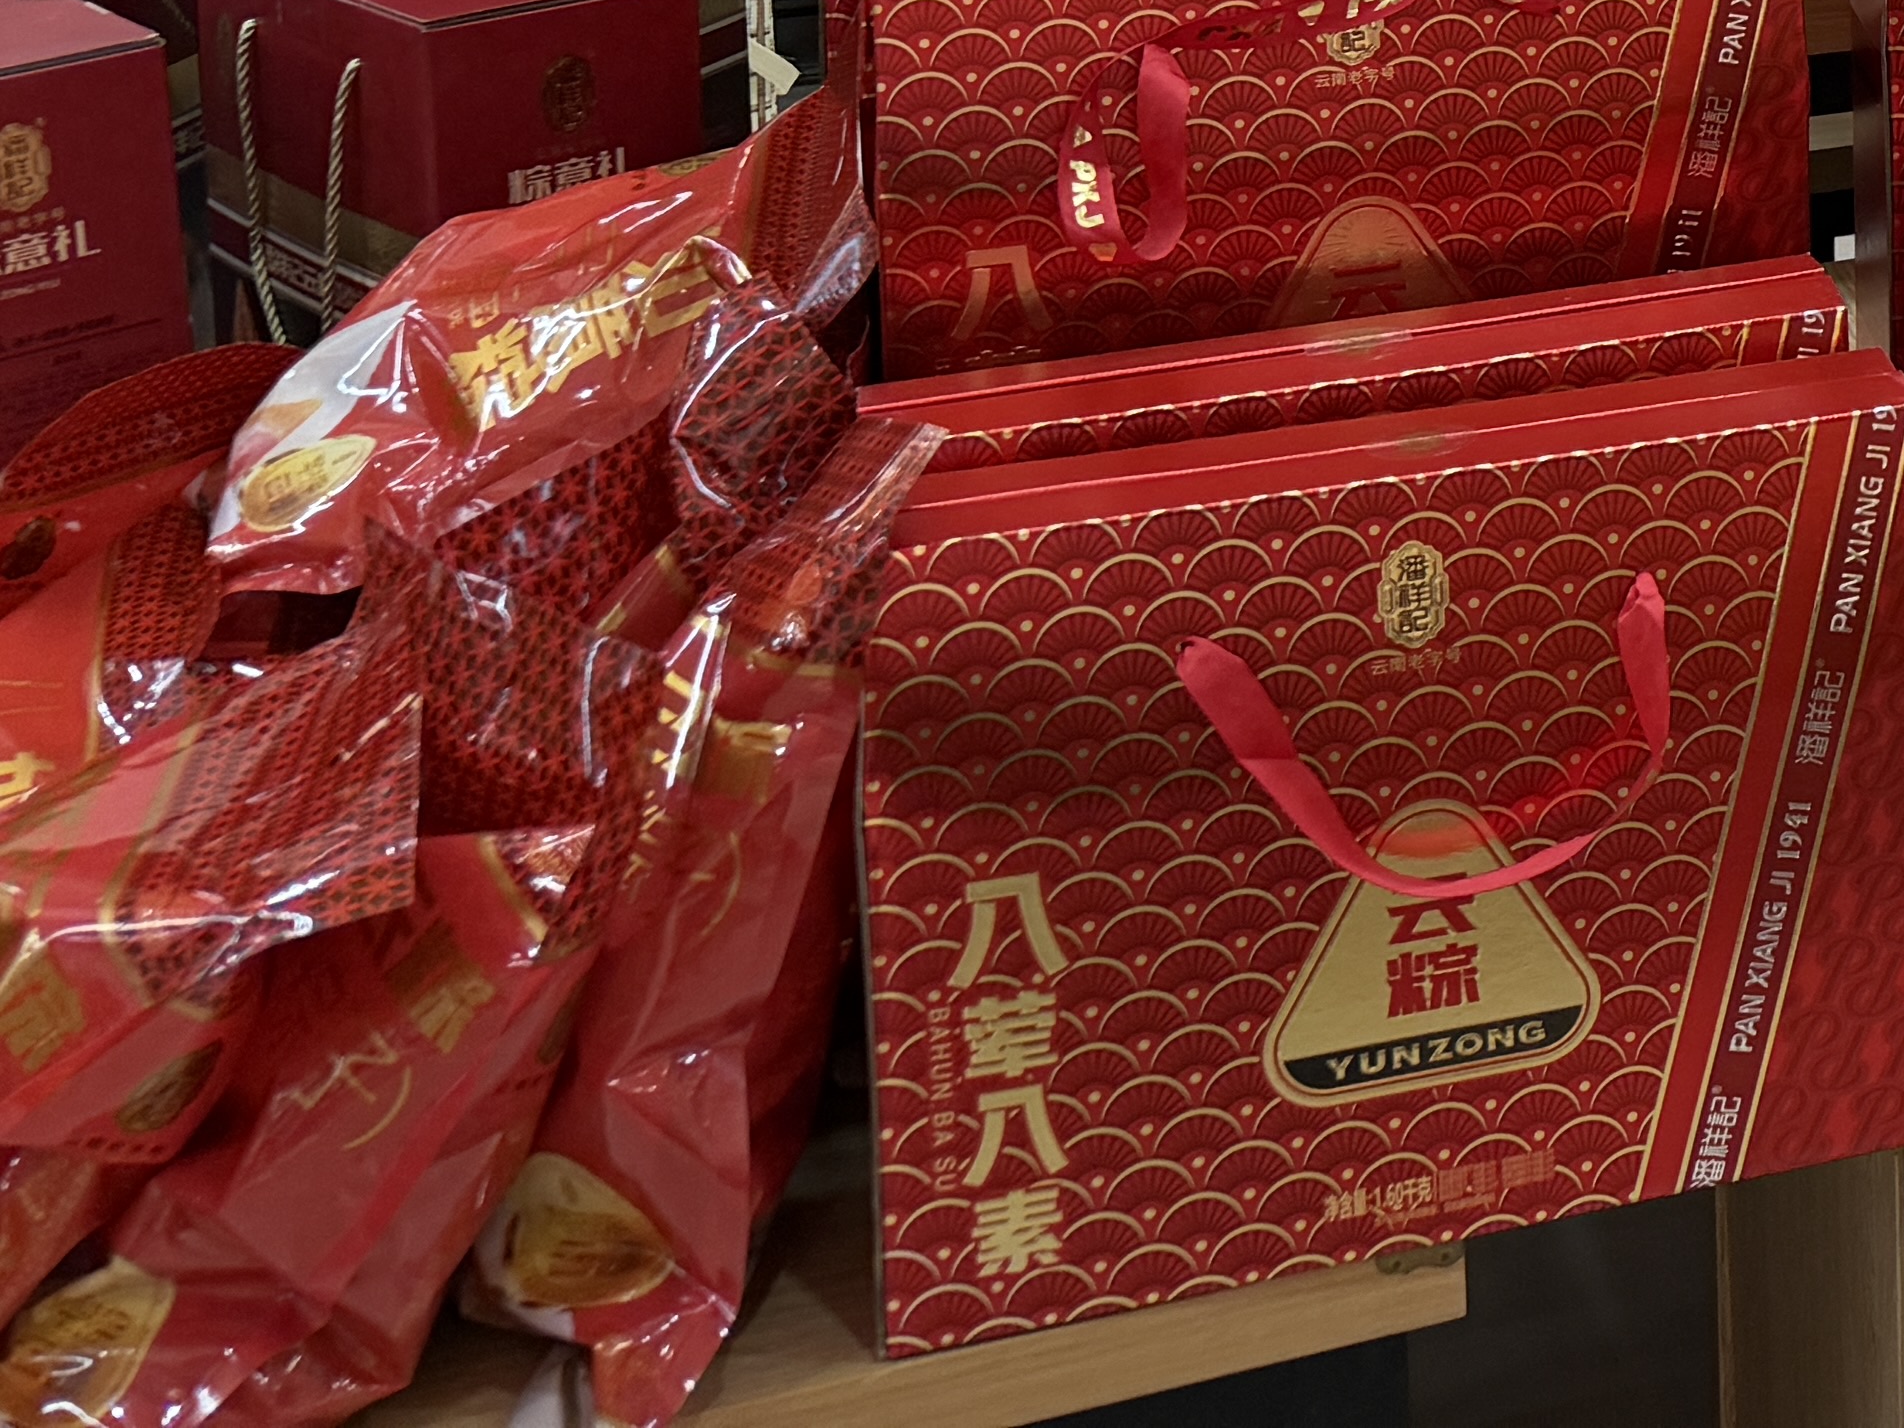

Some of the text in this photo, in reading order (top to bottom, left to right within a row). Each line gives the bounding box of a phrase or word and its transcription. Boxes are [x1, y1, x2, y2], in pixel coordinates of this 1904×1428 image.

[1314, 67, 1396, 90] 云南老字号
[508, 147, 625, 206] 粽意礼
[1729, 802, 1812, 1055] PAN XIANG JI 1941
[947, 871, 1069, 1277] 八荤八素
[1326, 1016, 1547, 1081] YUNZONG
